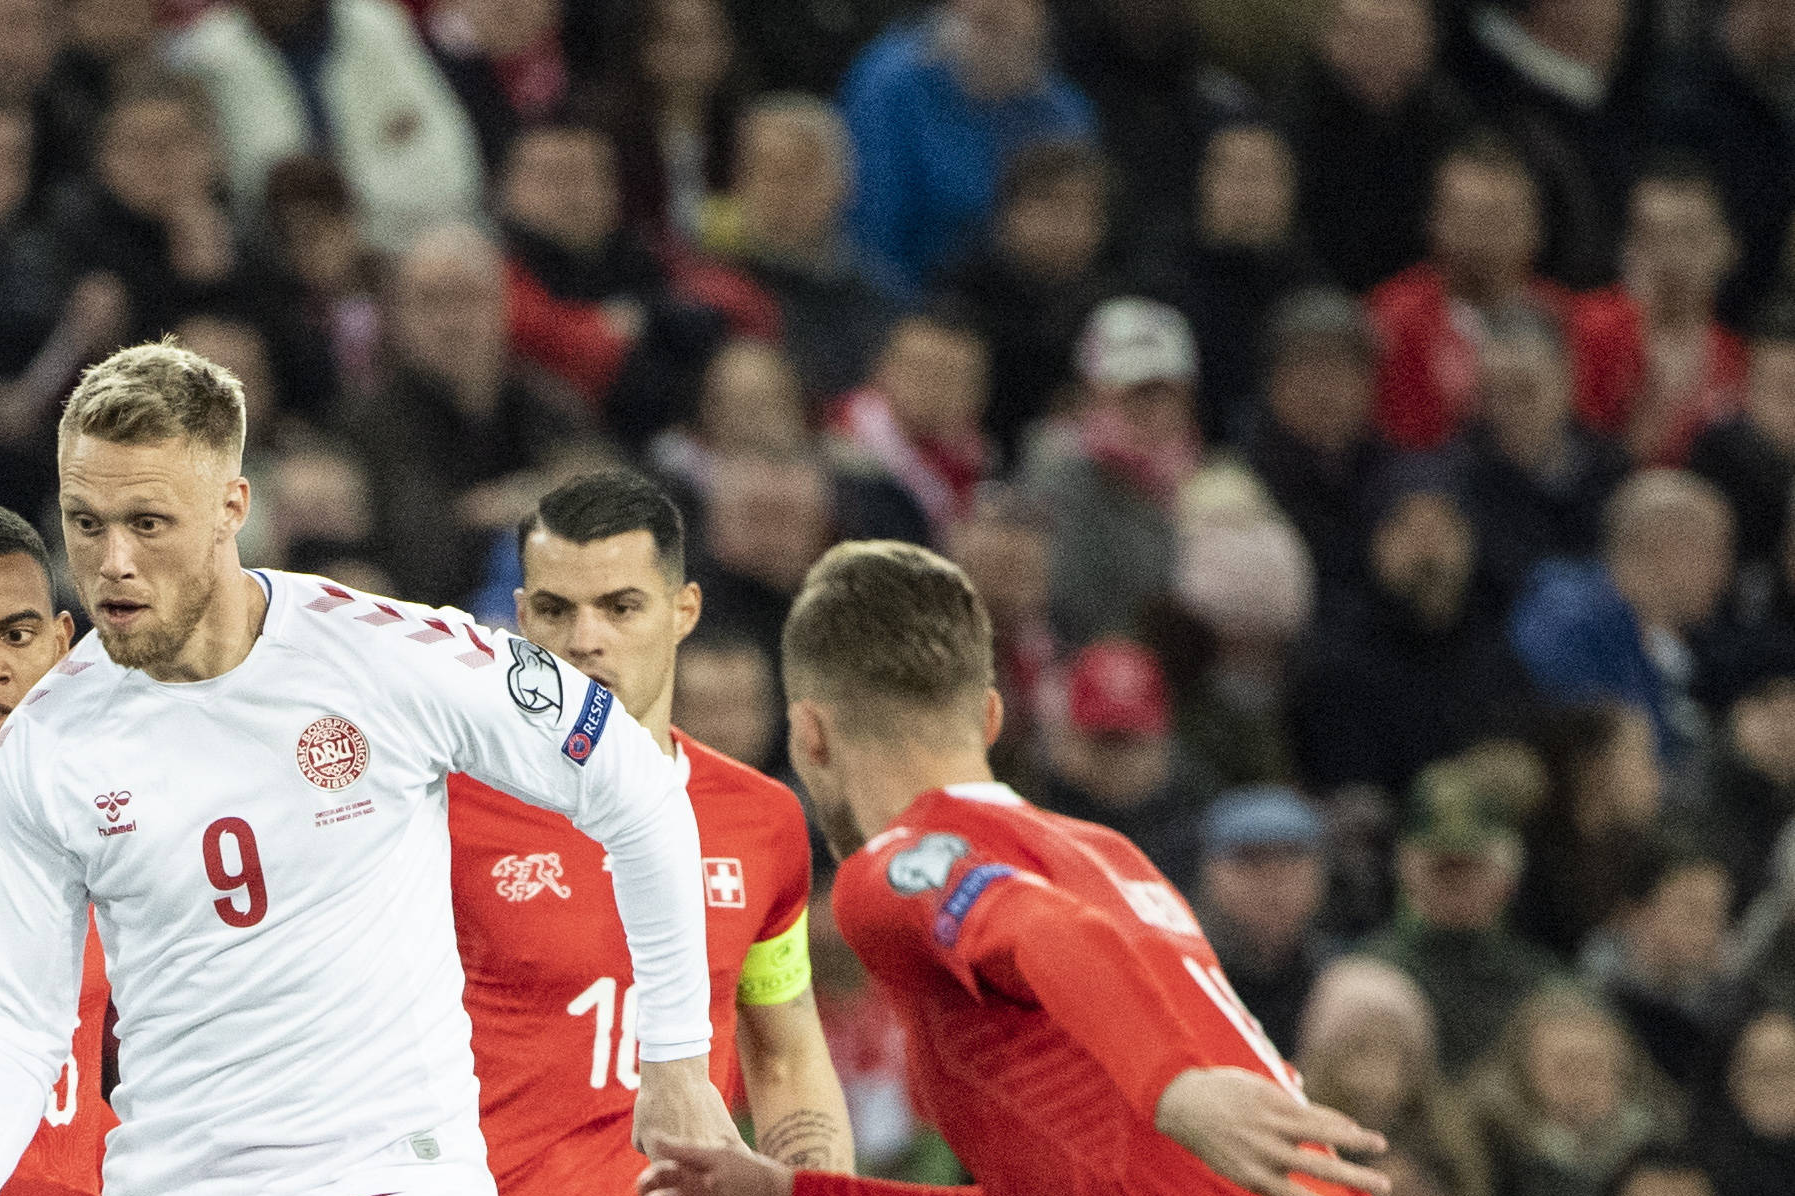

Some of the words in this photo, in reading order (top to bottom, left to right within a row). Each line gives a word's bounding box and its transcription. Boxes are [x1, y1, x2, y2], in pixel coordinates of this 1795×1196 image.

[582, 684, 609, 736] RESPE
[309, 738, 354, 768] DBU
[351, 731, 366, 774] UNION
[326, 771, 355, 789] 1889
[97, 820, 137, 837] hummel
[202, 816, 268, 928] 9
